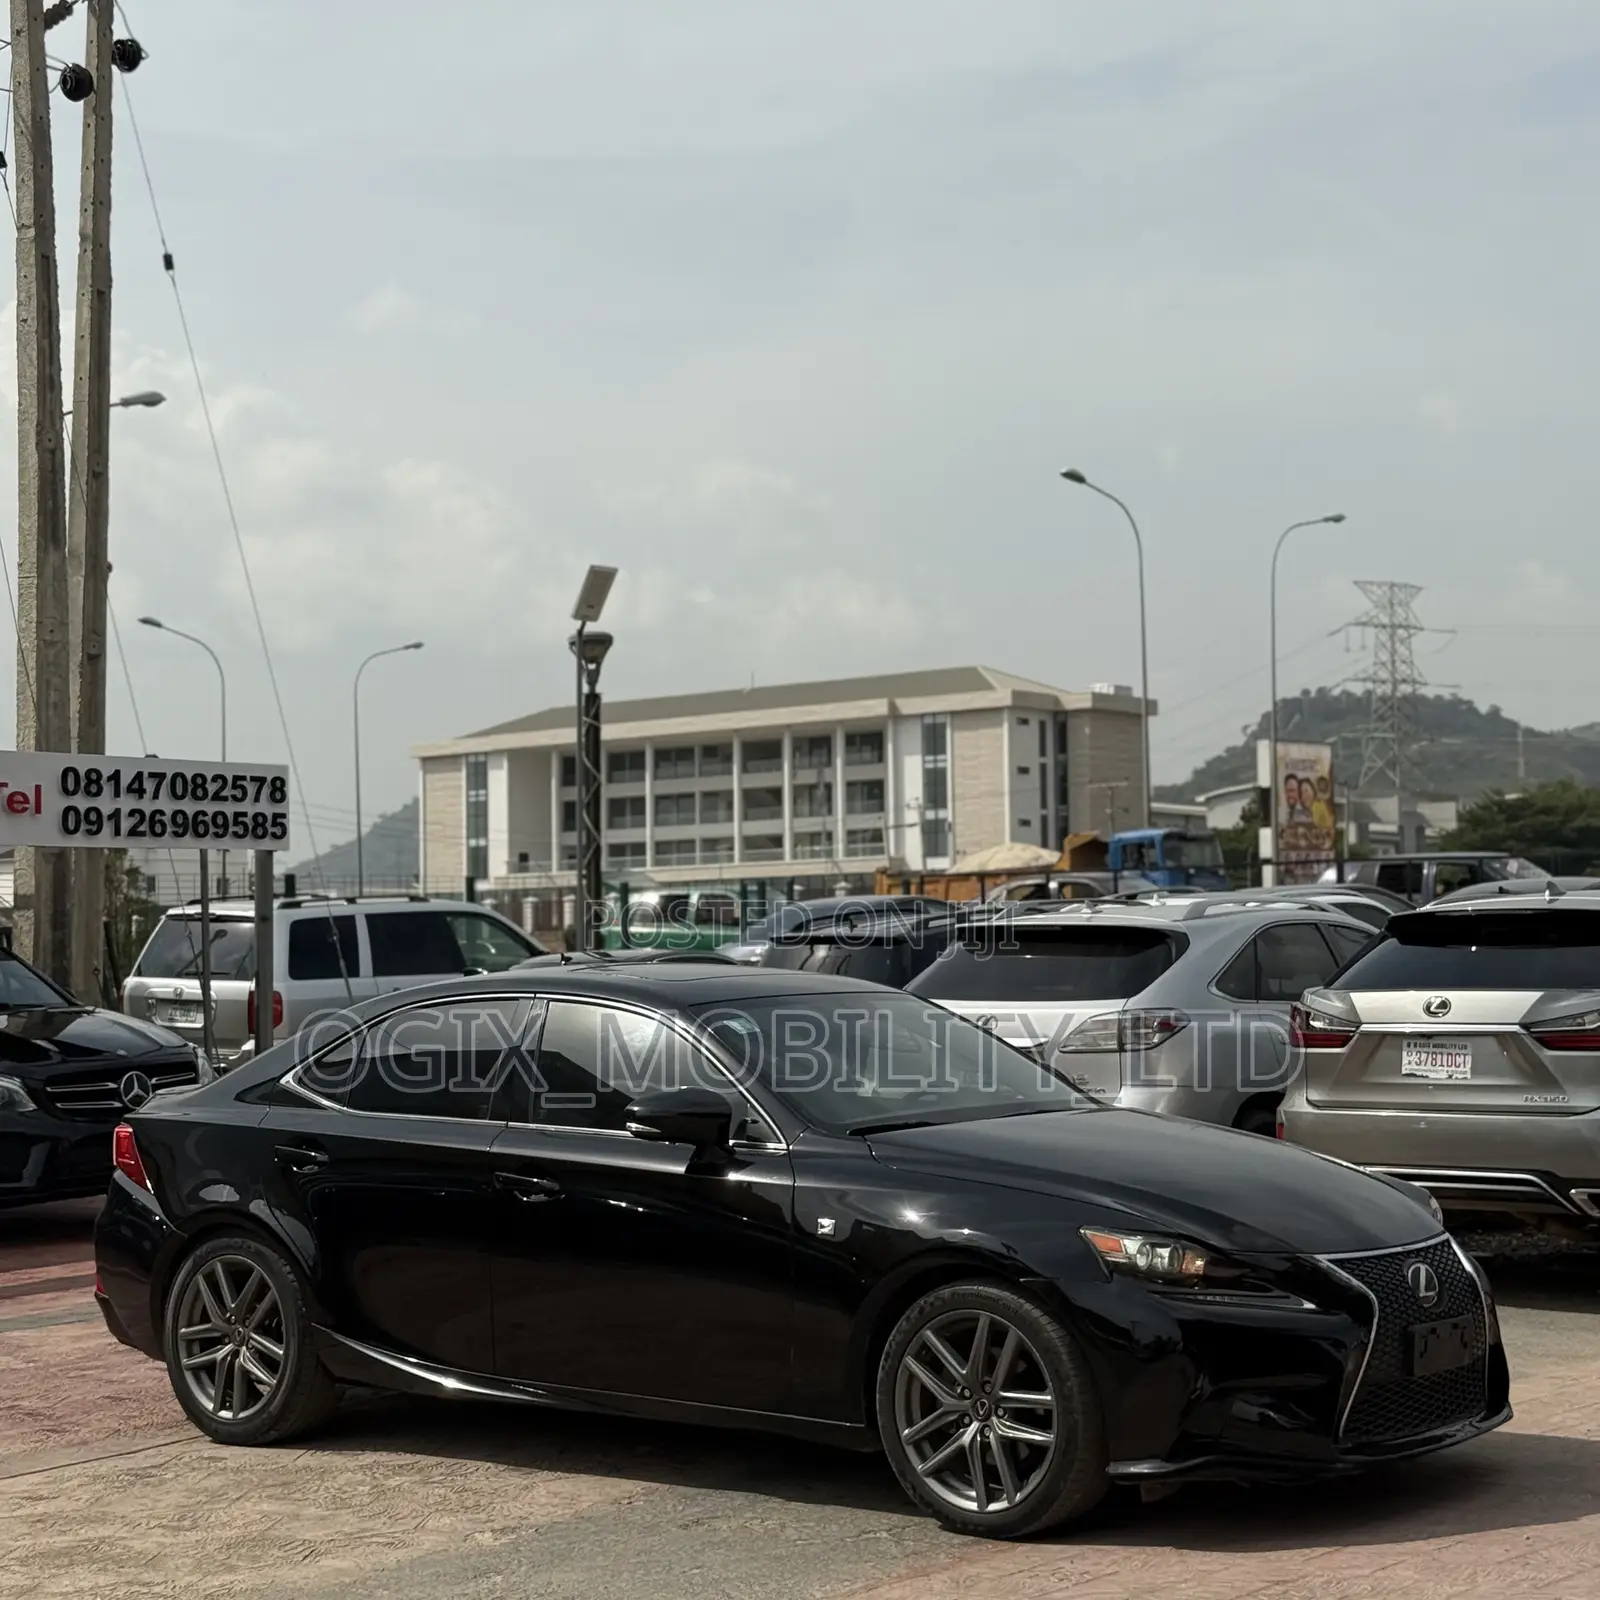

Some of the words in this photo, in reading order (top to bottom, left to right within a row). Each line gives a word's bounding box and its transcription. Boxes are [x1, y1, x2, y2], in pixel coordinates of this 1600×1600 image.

[60, 766, 287, 803] 08147082578
[60, 805, 288, 839] 09126969585
[1414, 1050, 1469, 1068] 3781DCT
